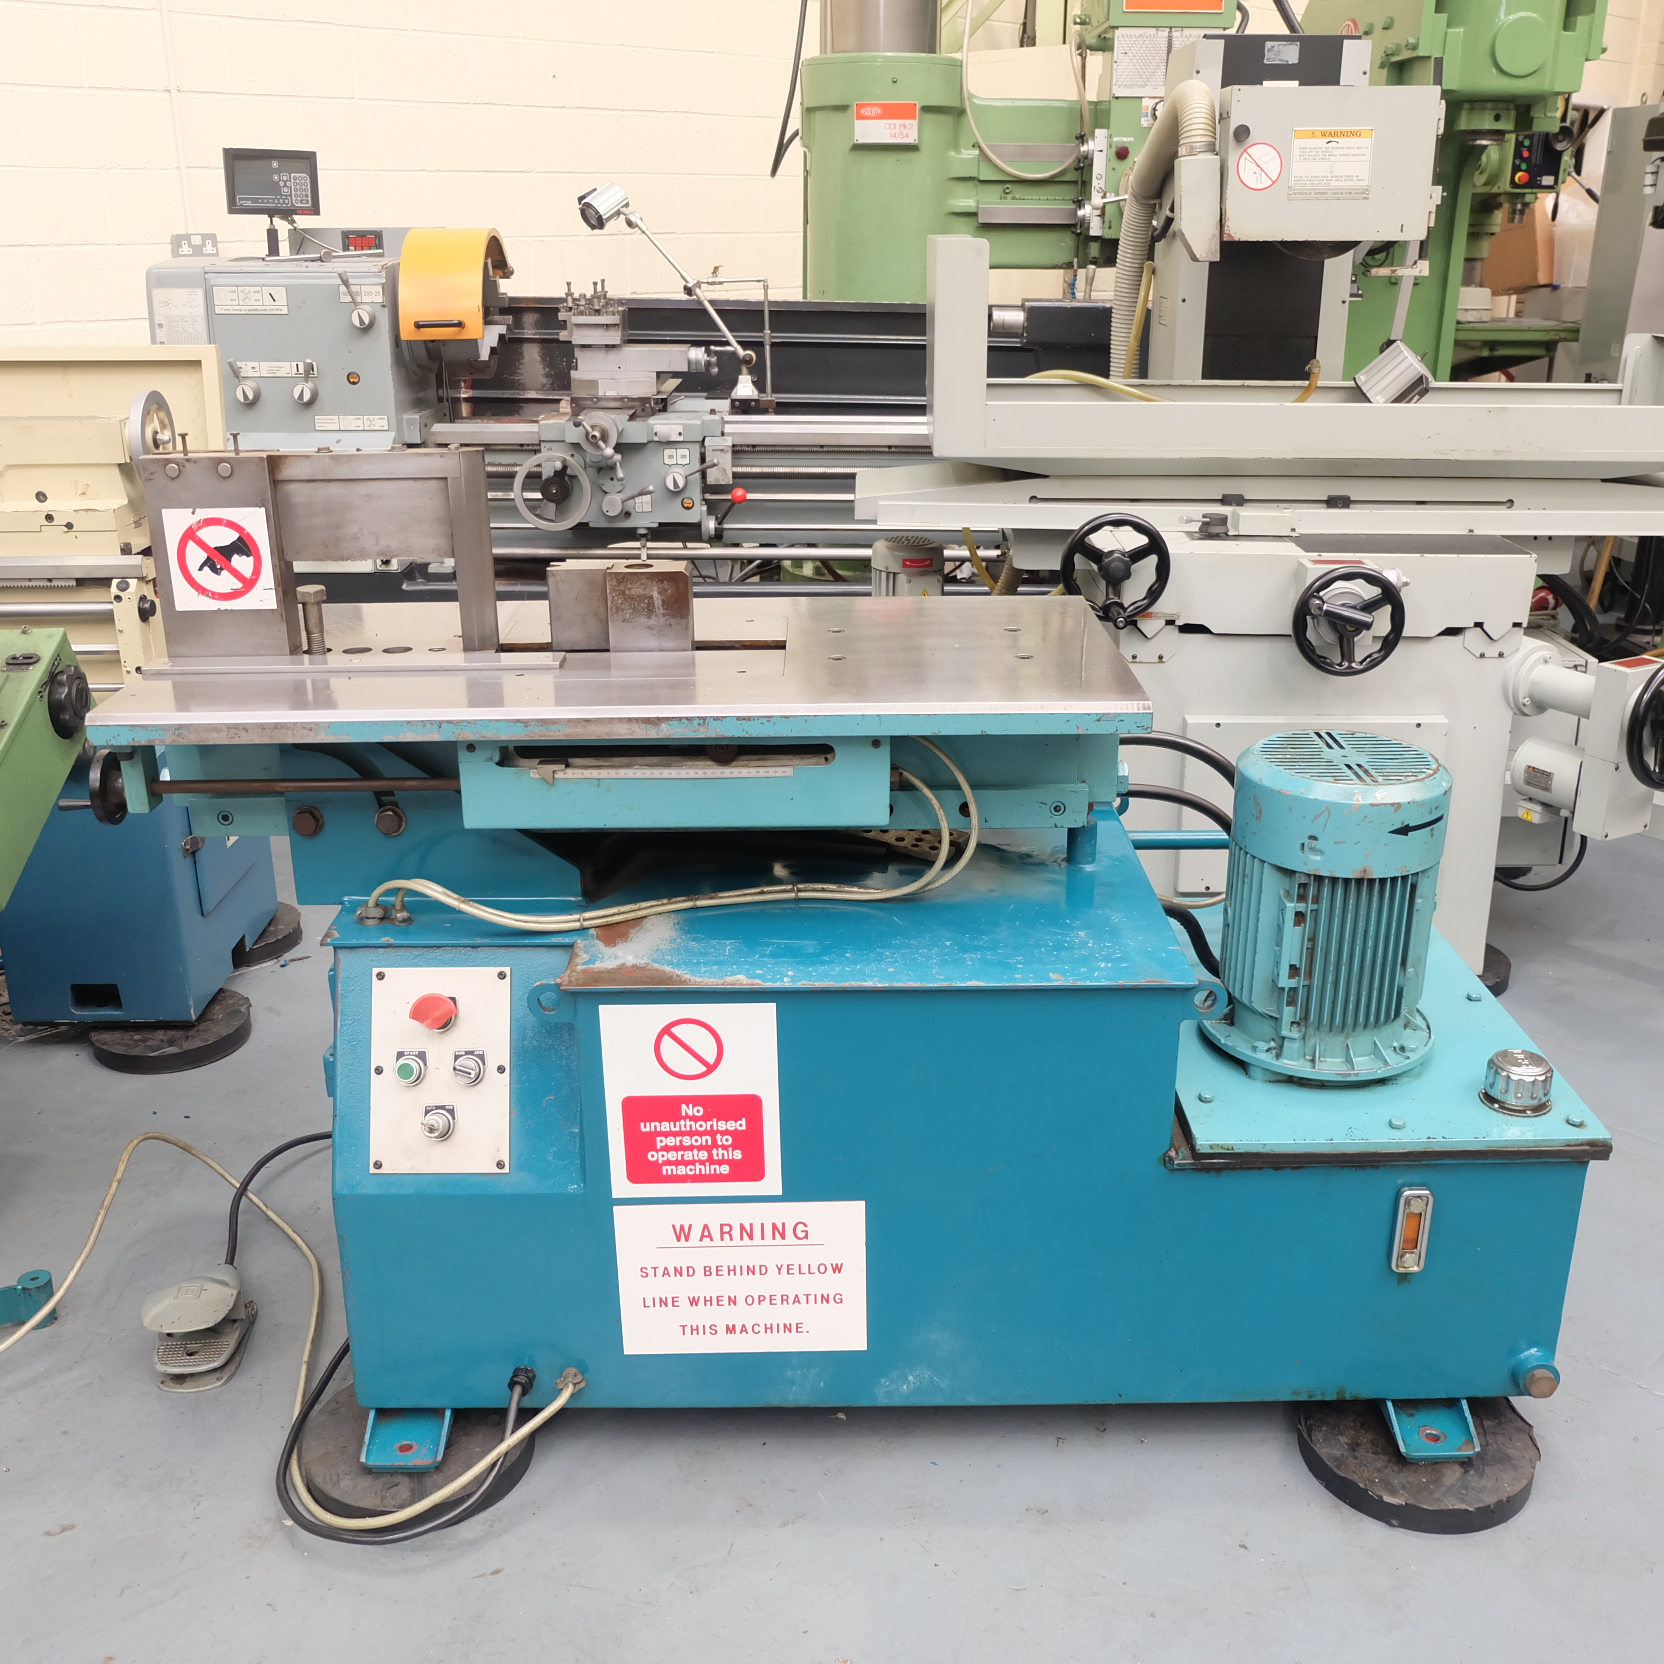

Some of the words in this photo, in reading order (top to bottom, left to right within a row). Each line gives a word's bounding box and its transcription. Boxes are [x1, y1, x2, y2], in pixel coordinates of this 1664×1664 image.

[1320, 130, 1362, 138] WARNING
[681, 1103, 704, 1117] No
[640, 1117, 746, 1132] unauthorised
[656, 1135, 712, 1149] person
[715, 1133, 733, 1146] to
[647, 1148, 708, 1164] operate
[711, 1147, 743, 1160] this
[662, 1162, 730, 1175] machine
[671, 1220, 810, 1243] WARNING
[639, 1265, 696, 1279] STAND
[703, 1264, 769, 1277] BEHIND
[775, 1262, 844, 1276] YELLOW
[642, 1295, 680, 1308] LINE
[687, 1294, 738, 1307] WHEN
[744, 1292, 844, 1307] OPERATING
[679, 1323, 718, 1336] THIS
[725, 1322, 810, 1335] MACHINE.
